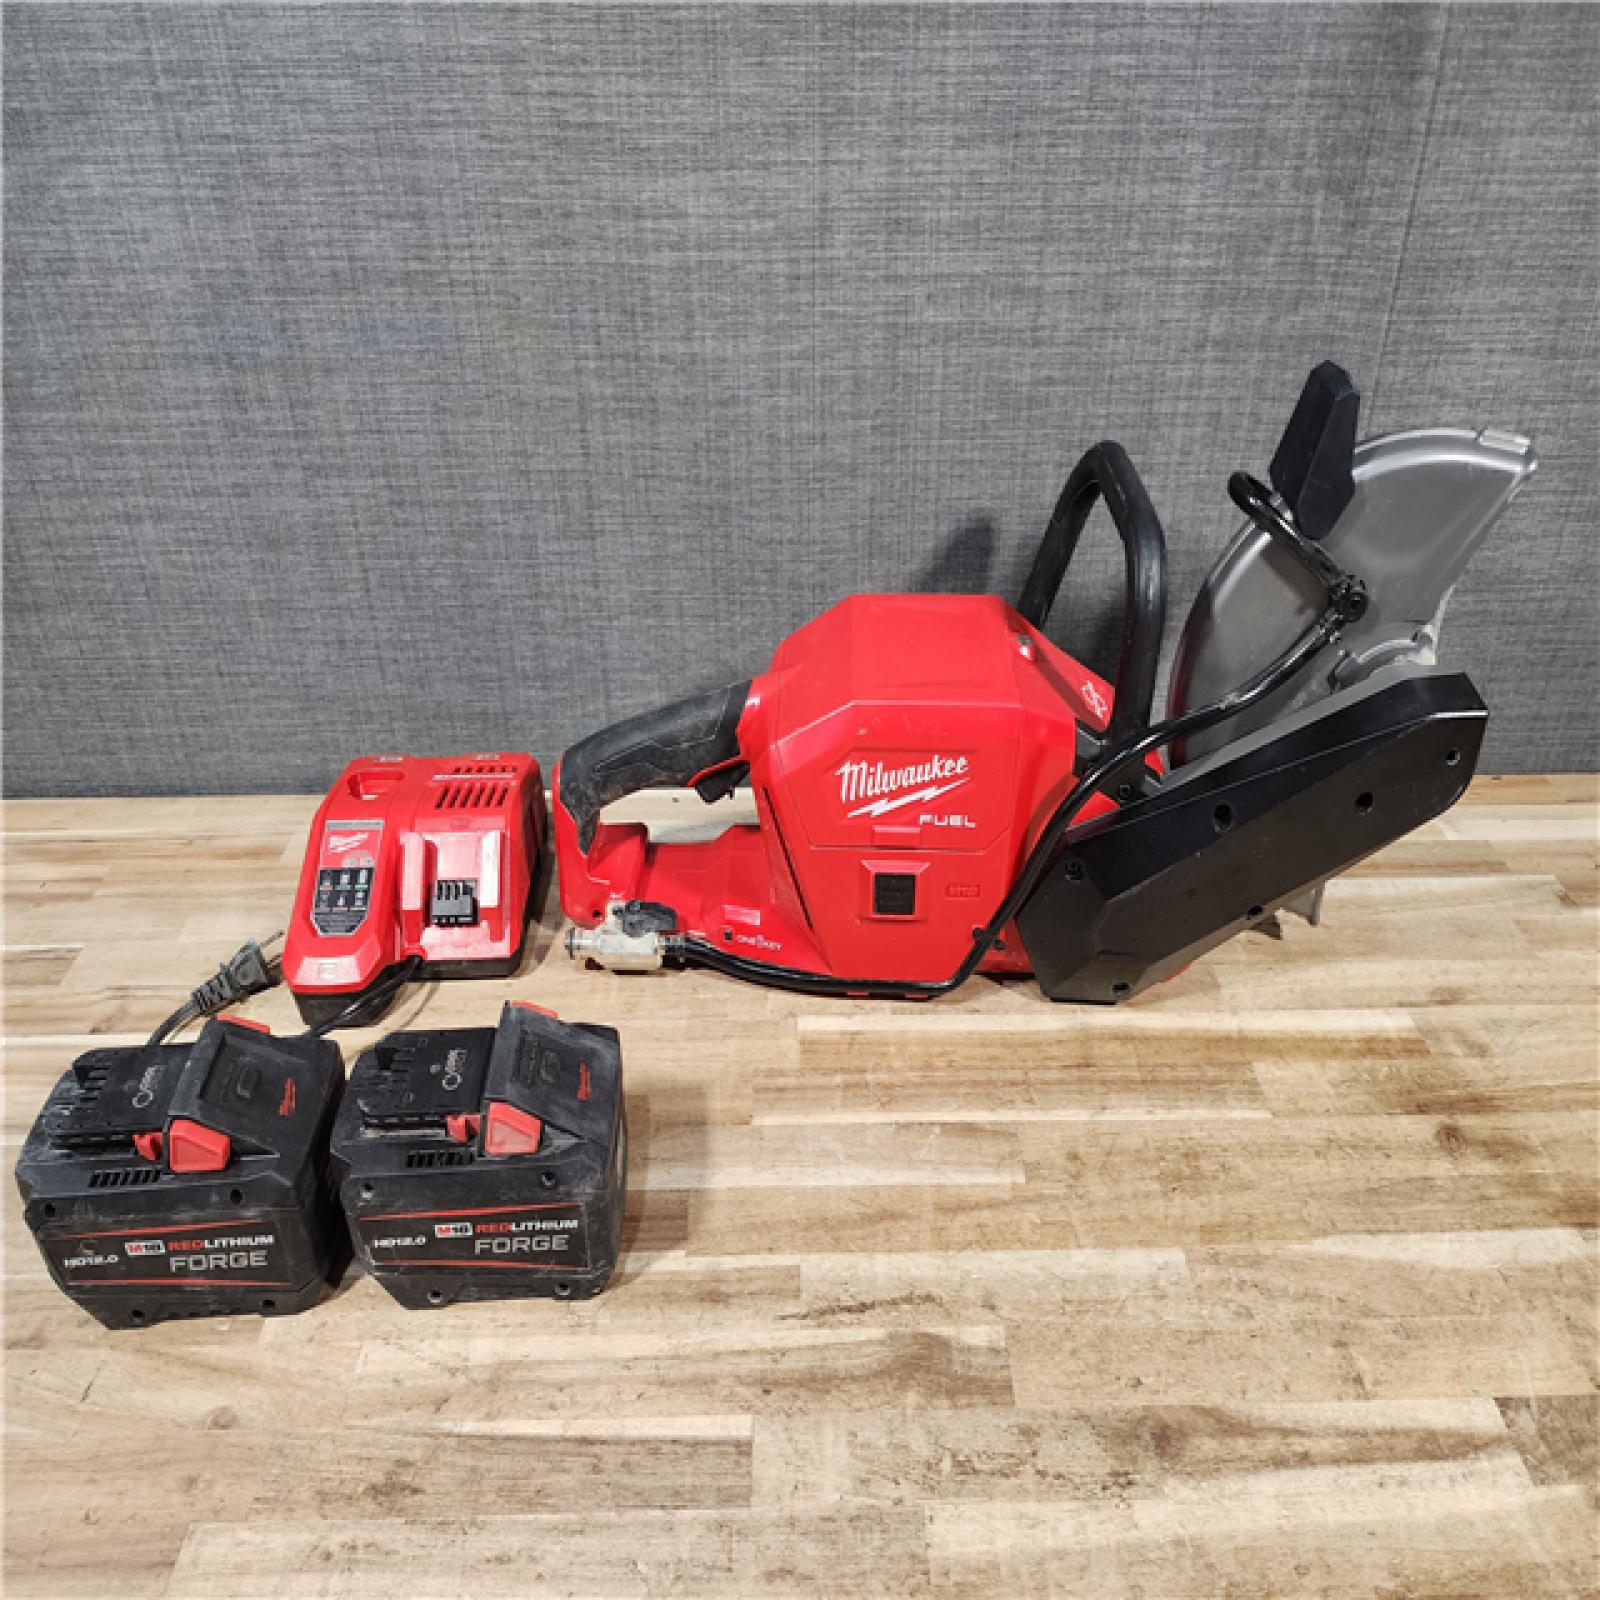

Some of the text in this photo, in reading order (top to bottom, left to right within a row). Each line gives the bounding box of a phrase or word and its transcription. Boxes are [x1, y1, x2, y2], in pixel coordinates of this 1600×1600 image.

[835, 755, 968, 803] Milwaukee
[919, 814, 977, 828] FUEL
[475, 1219, 579, 1234] REDLITHIUM
[167, 1234, 275, 1251] REDLITHIUM
[474, 1234, 569, 1255] FORGE
[169, 1249, 268, 1273] FORGE
